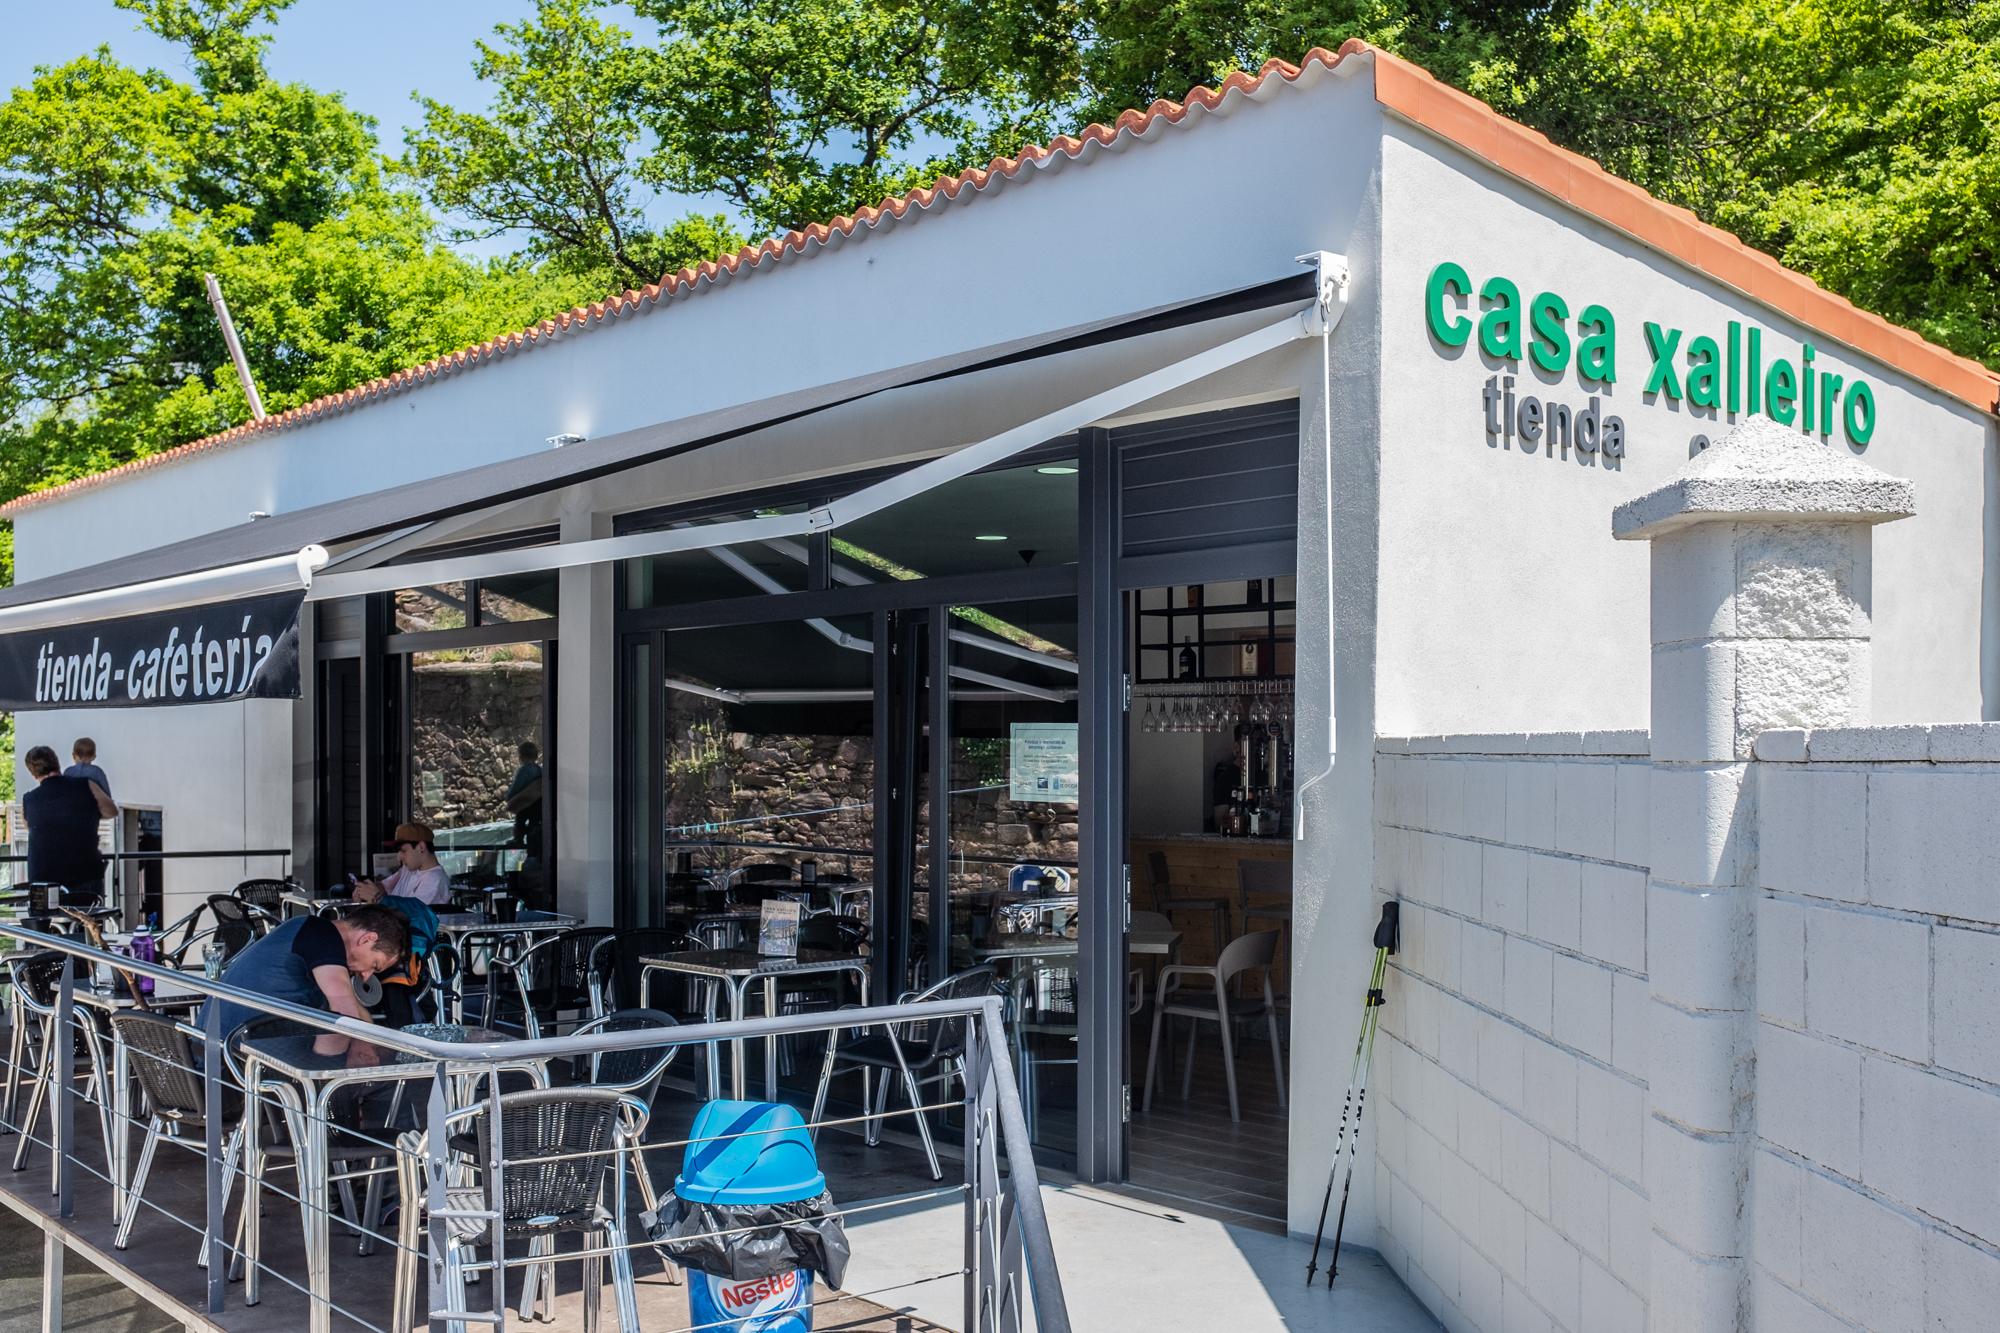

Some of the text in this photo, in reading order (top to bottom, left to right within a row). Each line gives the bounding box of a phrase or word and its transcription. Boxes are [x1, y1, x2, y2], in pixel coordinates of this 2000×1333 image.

[1425, 262, 1876, 445] casa xalleiro
[1483, 375, 1625, 459] tienda
